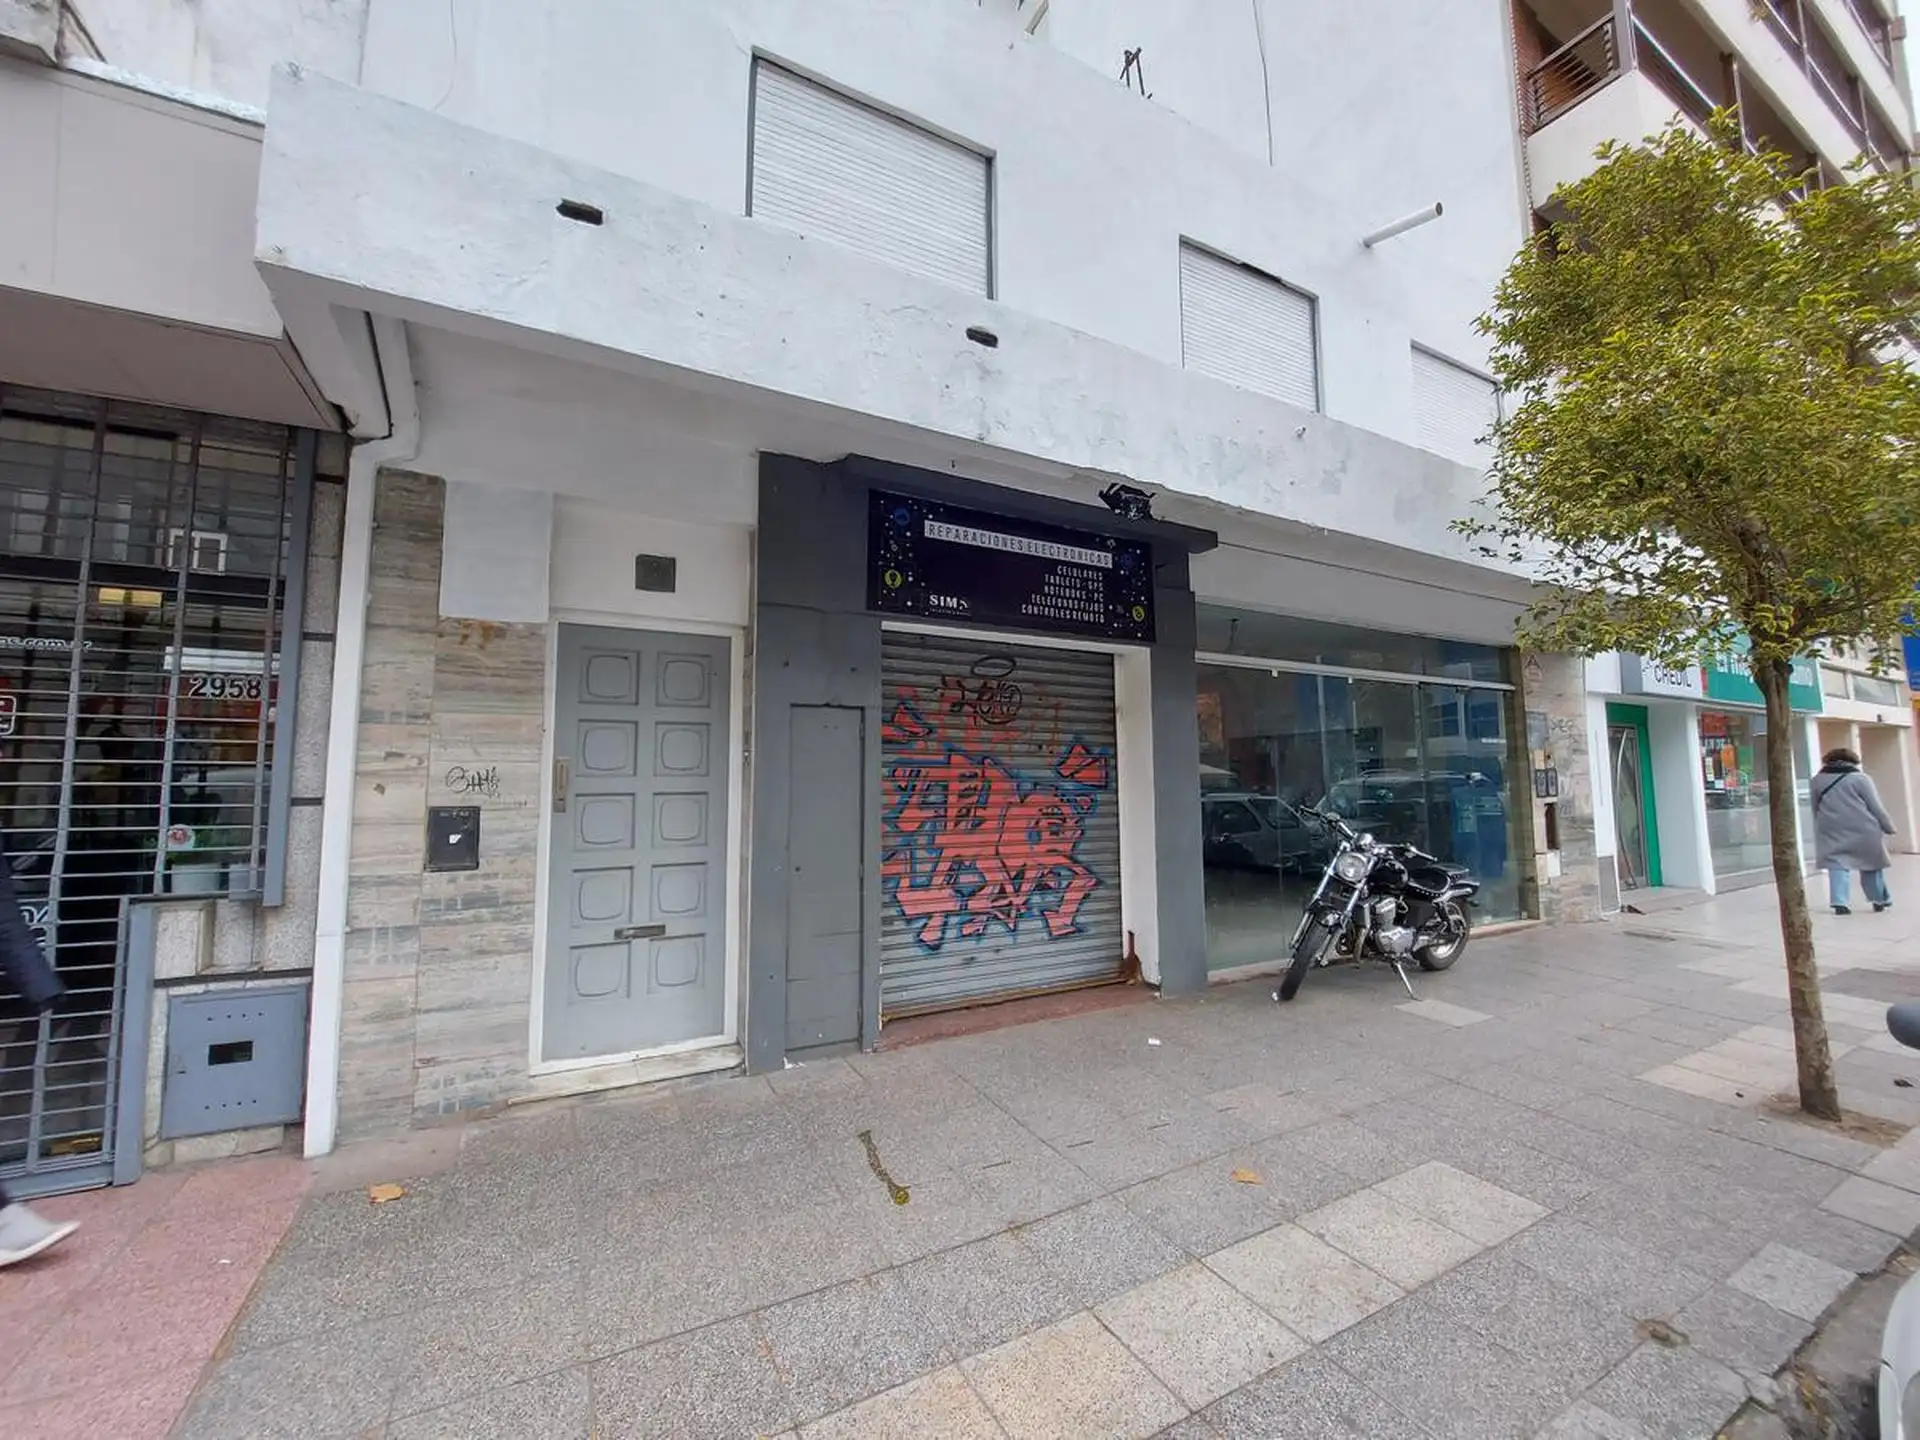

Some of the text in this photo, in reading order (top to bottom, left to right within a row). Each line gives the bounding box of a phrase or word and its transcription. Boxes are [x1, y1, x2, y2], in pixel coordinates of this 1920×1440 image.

[928, 522, 1110, 567] REPARACIONES ELECTRONICAS
[1044, 573, 1081, 588] TABLETS
[1057, 564, 1103, 581] CELULARES
[1031, 593, 1079, 610] TELEFONOS
[1021, 603, 1071, 619] CONTROLES
[188, 673, 261, 699] 2958
